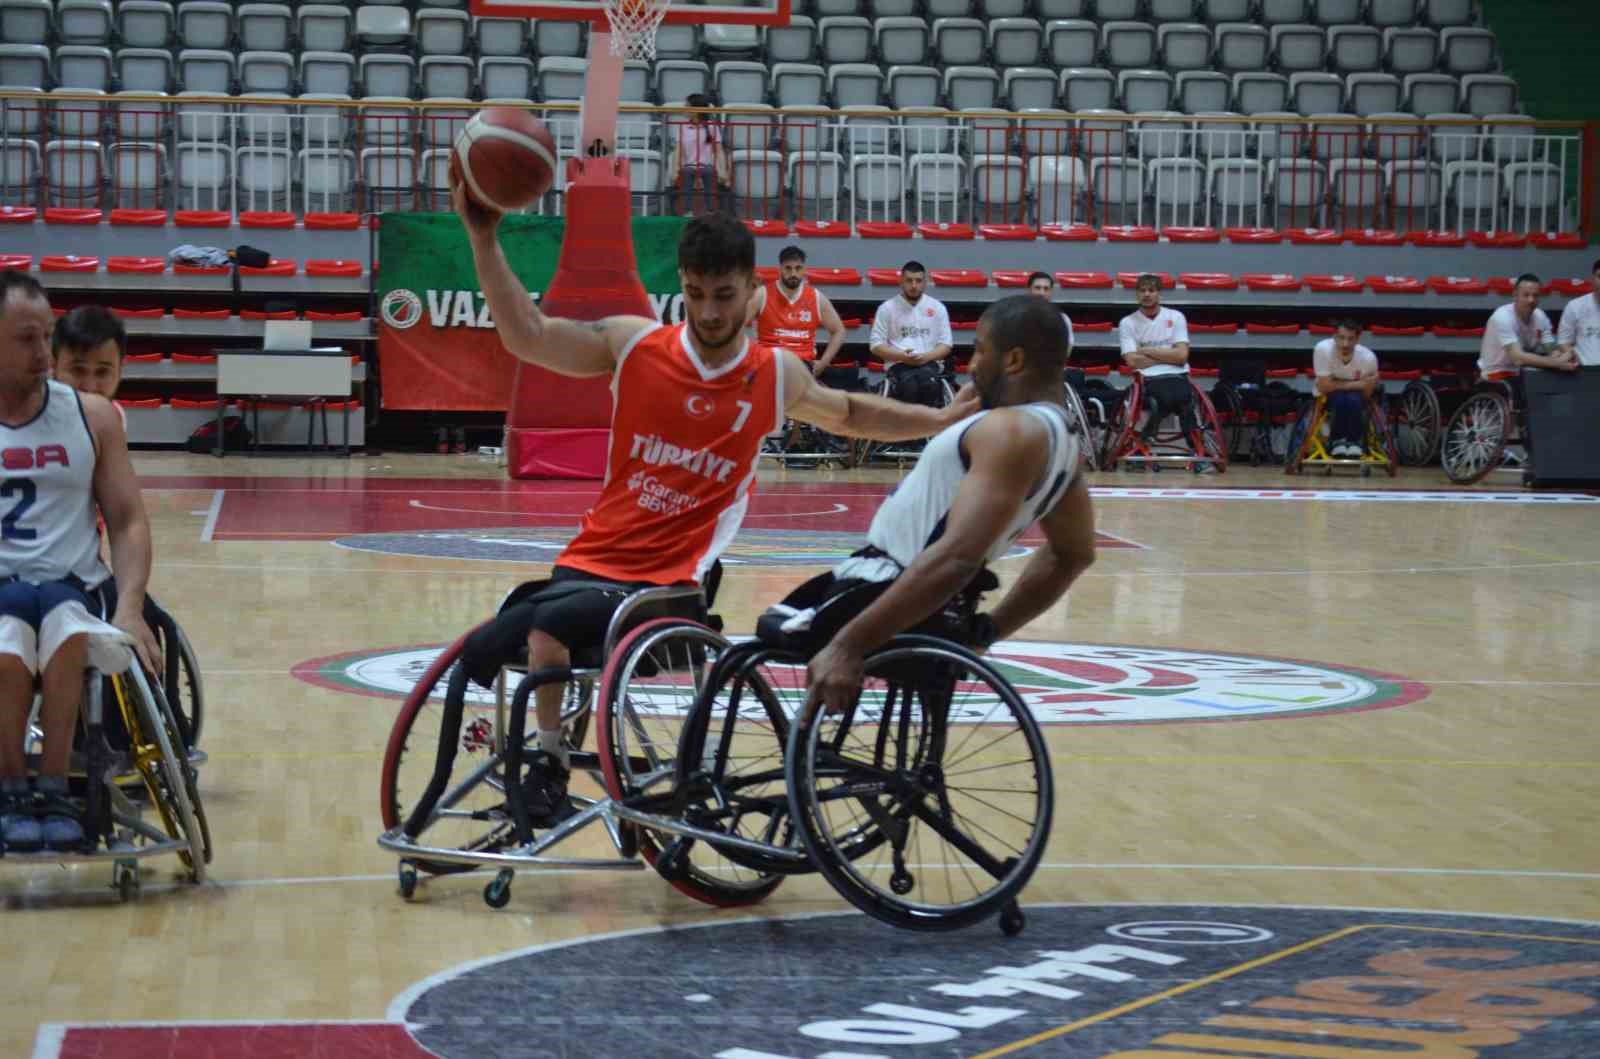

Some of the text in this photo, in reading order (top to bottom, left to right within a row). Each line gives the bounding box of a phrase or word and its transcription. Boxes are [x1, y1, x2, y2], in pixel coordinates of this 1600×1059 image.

[731, 400, 753, 432] 7
[0, 444, 70, 470] SA
[0, 477, 37, 540] 2
[928, 943, 1188, 1001] 444
